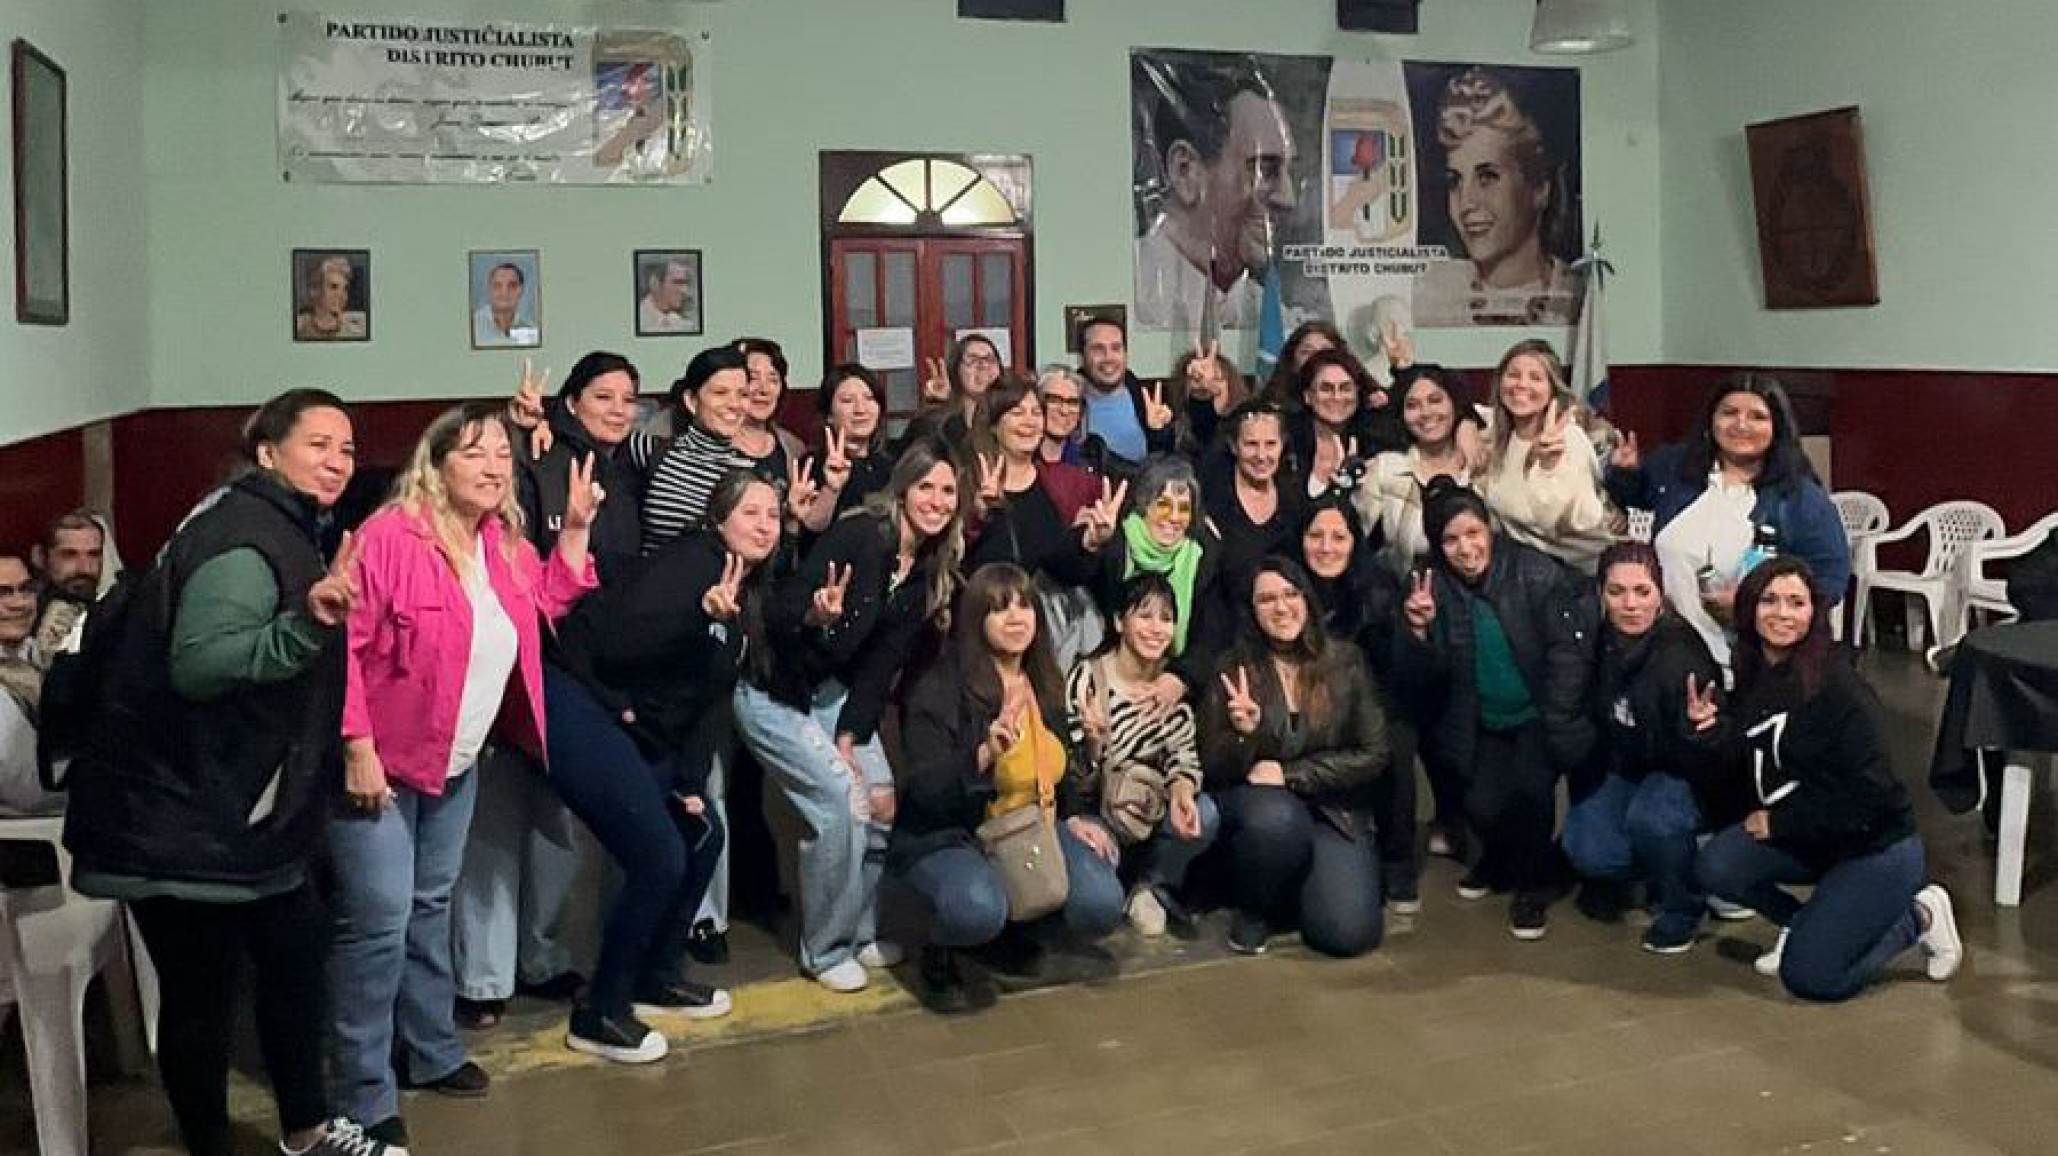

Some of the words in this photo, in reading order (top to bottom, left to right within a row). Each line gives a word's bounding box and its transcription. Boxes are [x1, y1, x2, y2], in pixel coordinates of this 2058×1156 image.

[326, 22, 419, 41] PARTIDO
[423, 26, 575, 48] JUSTICIALISTA
[386, 48, 485, 66] DISTRITO
[1284, 245, 1346, 260] PARTIDO
[1348, 245, 1448, 260] JUSTICIALISTA
[1304, 261, 1371, 275] DISTRITO
[1373, 261, 1429, 275] CHUBUT
